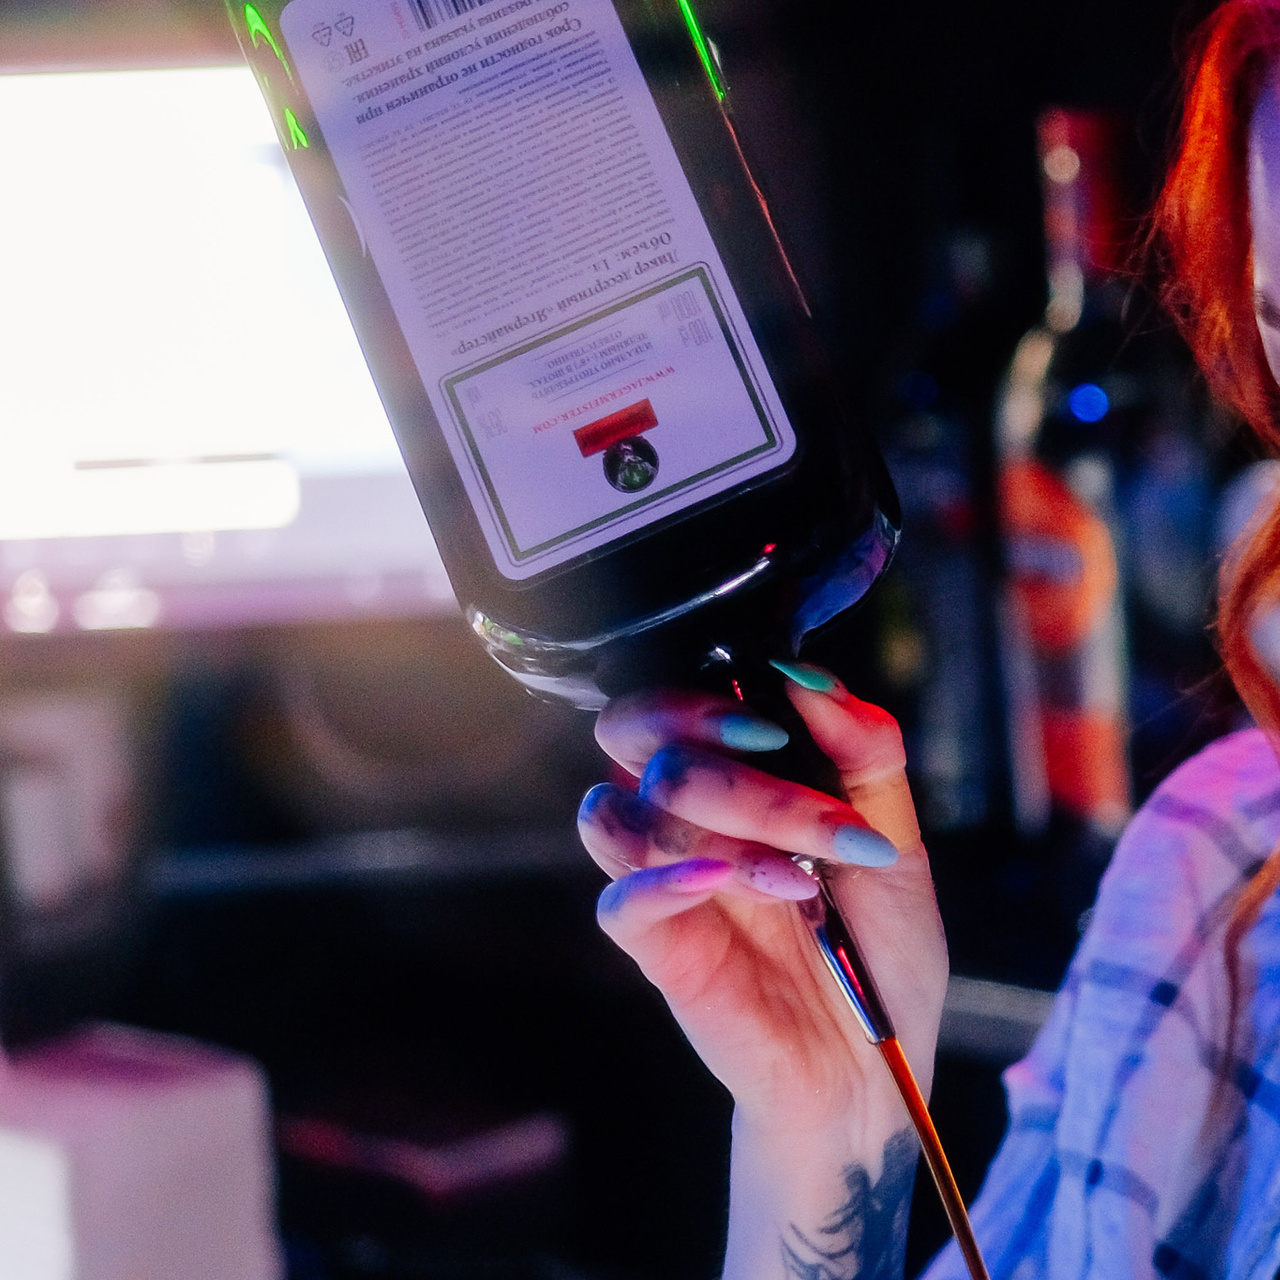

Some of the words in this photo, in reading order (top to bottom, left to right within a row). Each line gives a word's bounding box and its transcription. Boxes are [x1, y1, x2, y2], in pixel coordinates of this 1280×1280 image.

[421, 17, 476, 53] указана
[542, 12, 583, 44] Срок
[404, 44, 422, 61] на
[422, 36, 483, 76] условий
[478, 31, 543, 70] годности
[340, 52, 405, 91] этикетке.
[349, 62, 424, 107] хранения.
[458, 62, 478, 79] не
[382, 67, 459, 113] ограничен
[352, 101, 384, 126] при
[613, 229, 673, 267] Объем:
[630, 244, 680, 280] Ликер
[554, 265, 634, 314] десертный
[447, 300, 556, 361] «Ягермайстер»
[598, 339, 653, 371] ИДЕАЛЬНО
[529, 363, 677, 435] WWW.JAGERMEISTER.COM
